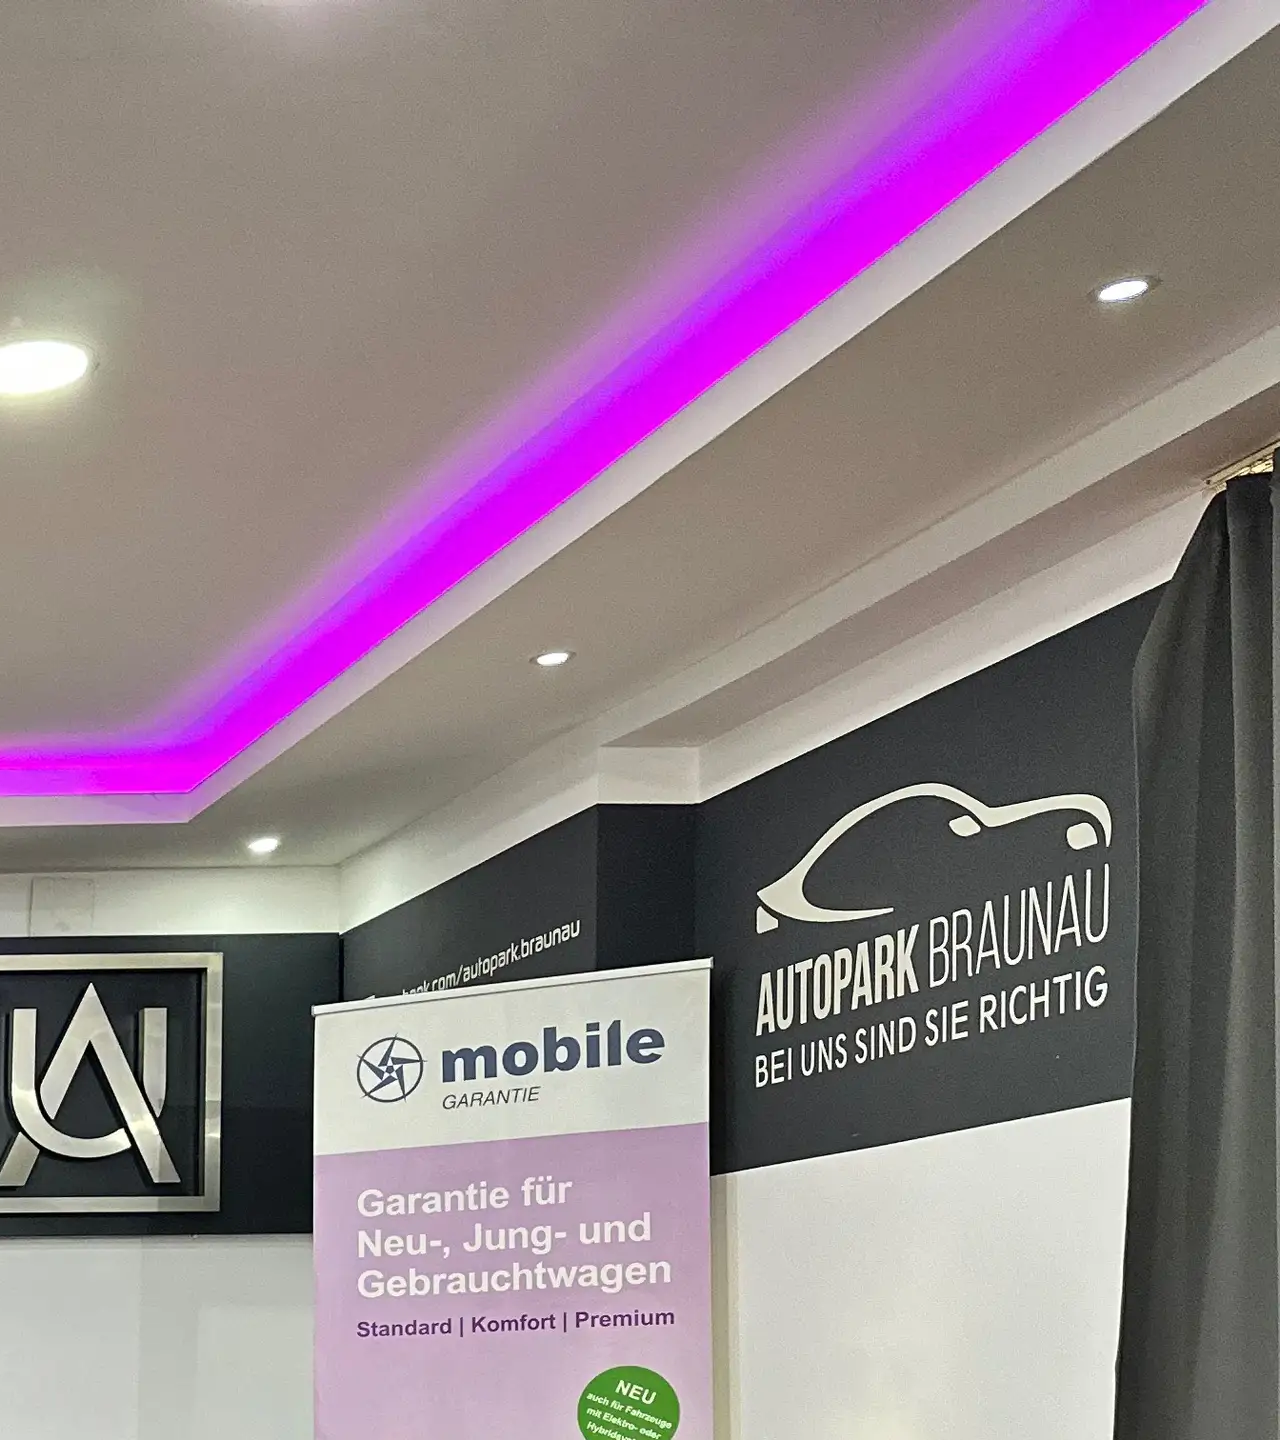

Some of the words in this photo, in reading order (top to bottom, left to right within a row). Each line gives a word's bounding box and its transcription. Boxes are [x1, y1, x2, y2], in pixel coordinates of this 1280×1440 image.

[402, 920, 580, 996] ok.com/autopark.braunau
[755, 924, 920, 1036] AUTOPARK
[928, 863, 1109, 988] BRAUNAU
[755, 1050, 793, 1088] BEI
[801, 1033, 848, 1077] UNS
[854, 1016, 917, 1064] SIND
[925, 1001, 969, 1047] SIE
[979, 965, 1108, 1033] RICHTIG
[442, 1019, 665, 1083] mobile
[442, 1086, 541, 1110] GARANTIE
[357, 1182, 510, 1218] Garantie
[521, 1175, 573, 1207] für
[357, 1228, 450, 1260] Neu-,
[463, 1222, 567, 1255] Jung-
[579, 1212, 651, 1245] und
[357, 1260, 672, 1298] Gebrauchtwagen
[357, 1318, 452, 1338] Standard
[471, 1313, 556, 1334] Komfort
[575, 1310, 675, 1329] Premium
[586, 1393, 609, 1406] auch
[625, 1405, 672, 1429] Fahrzeuge
[615, 1379, 656, 1404] NEU
[586, 1408, 602, 1418] mit
[603, 1412, 638, 1431] Elektro-
[639, 1428, 661, 1440] oder
